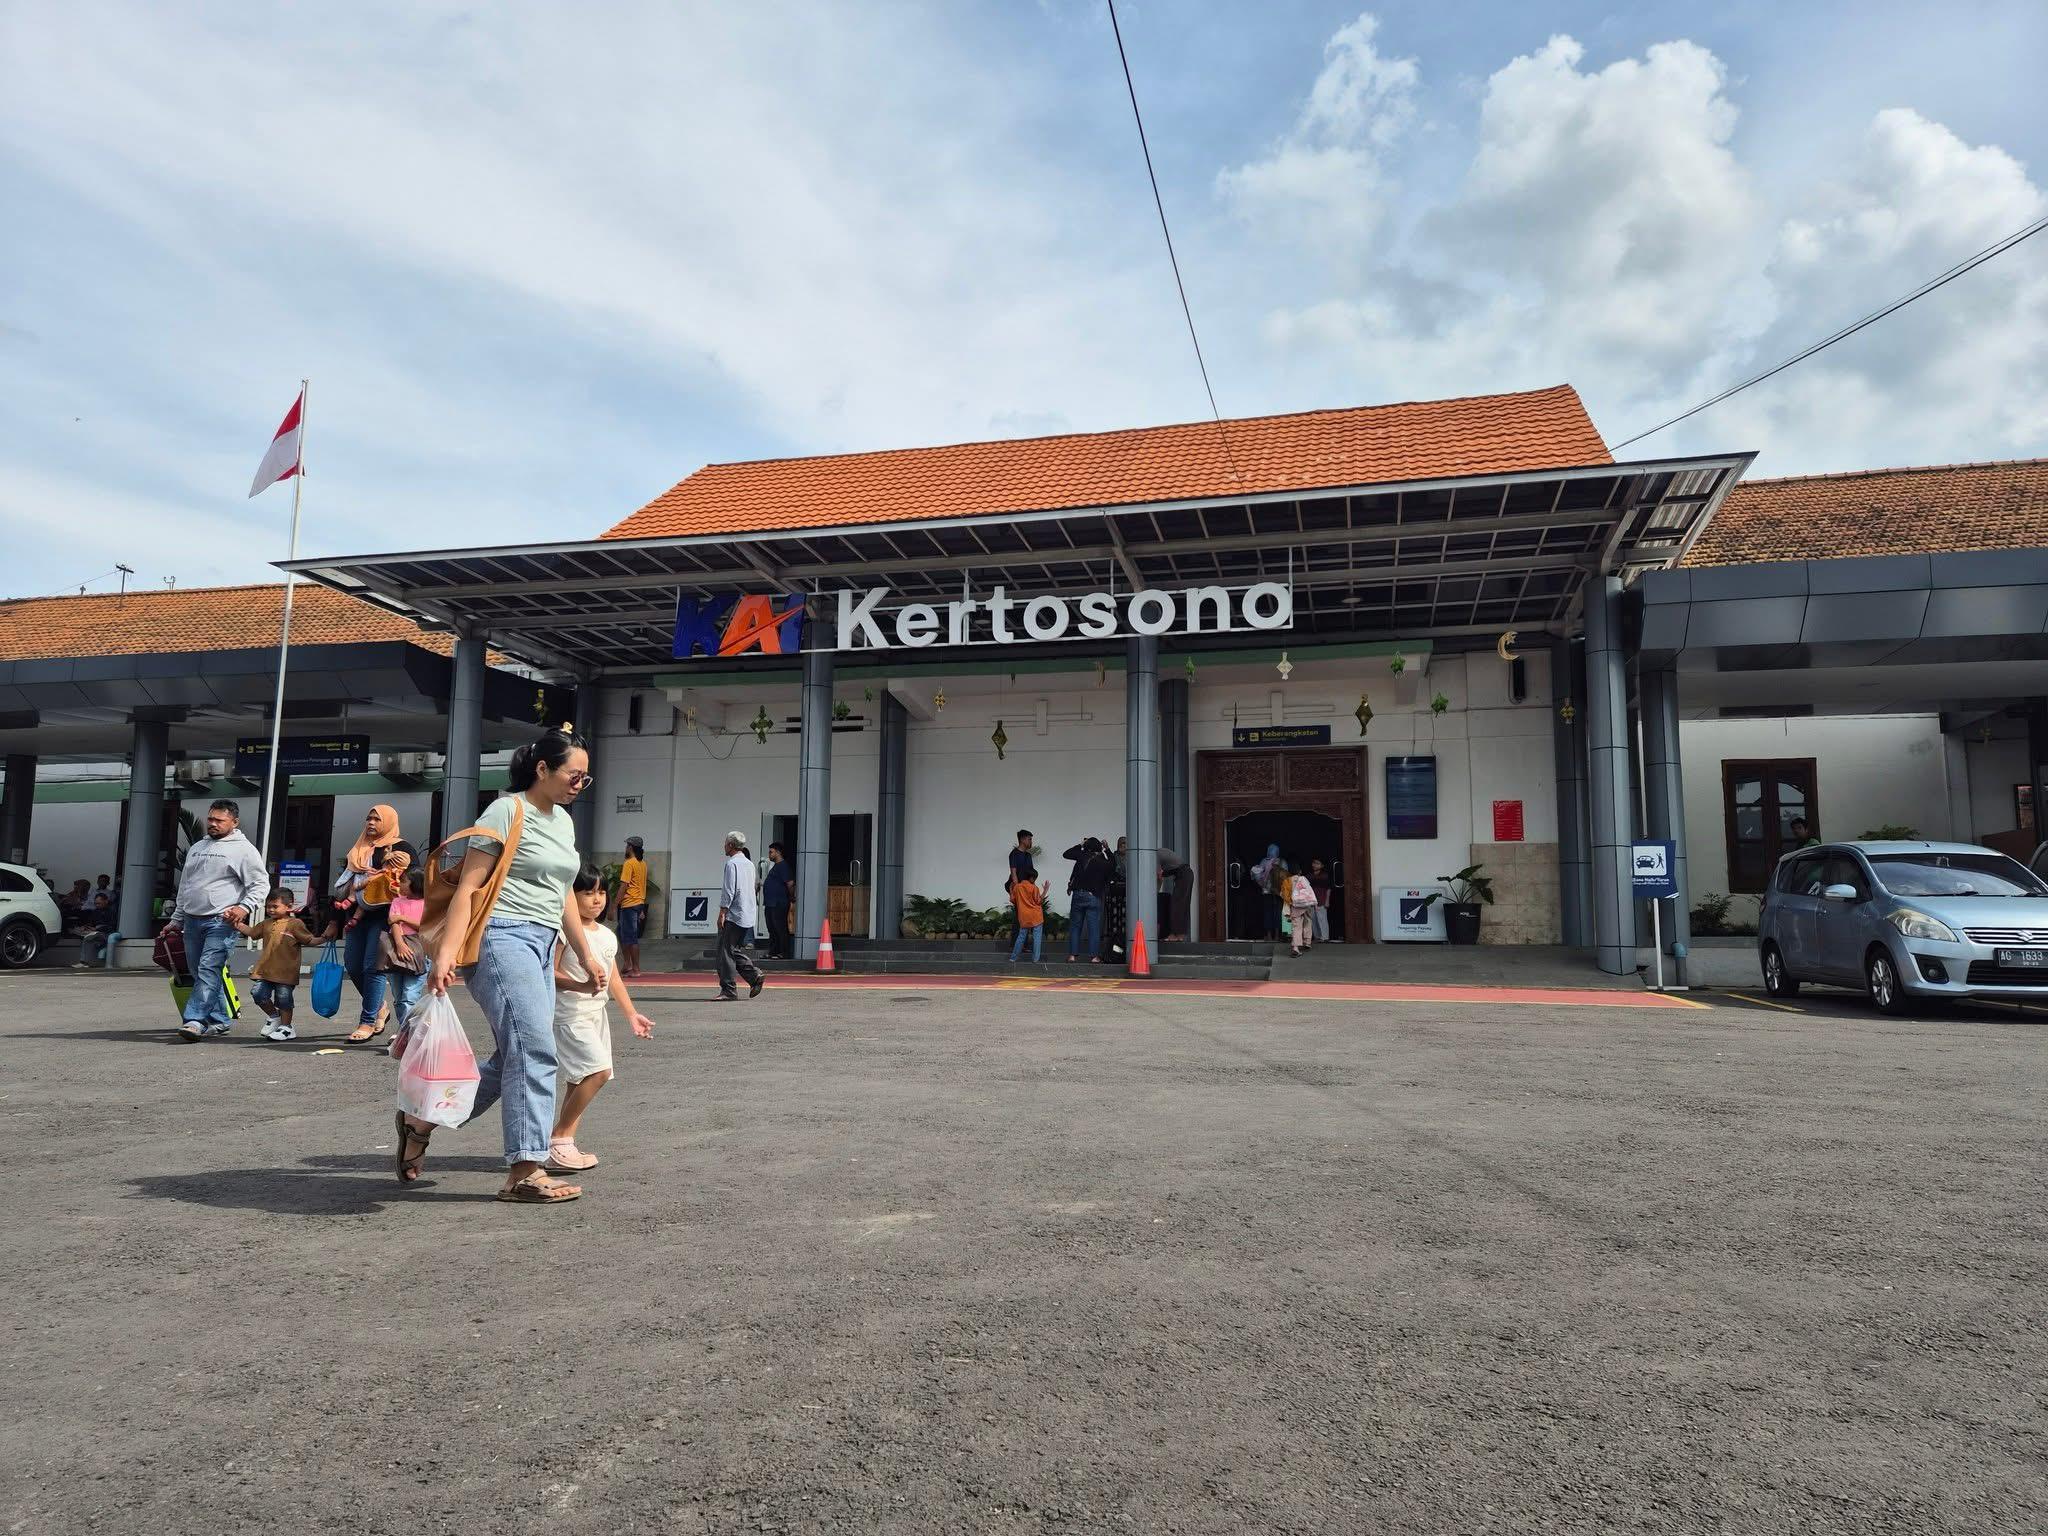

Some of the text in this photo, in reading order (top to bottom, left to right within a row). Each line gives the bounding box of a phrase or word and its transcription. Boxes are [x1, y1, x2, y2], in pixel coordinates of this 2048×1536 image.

[672, 582, 1292, 658] KAI Kertosono
[1262, 730, 1319, 738] Keberangkatan
